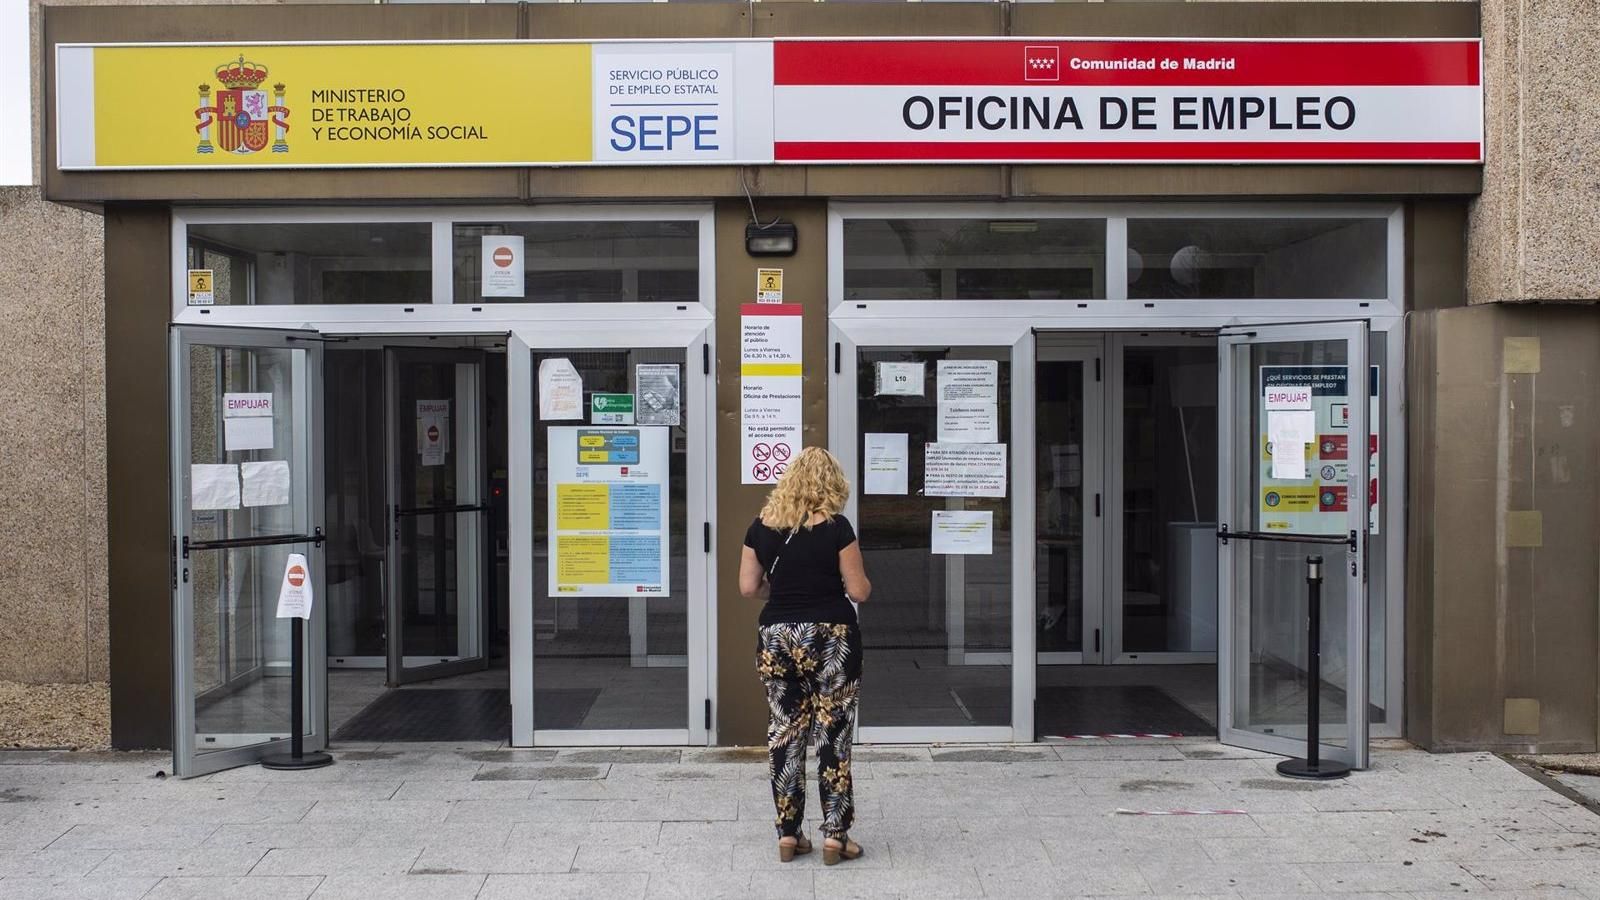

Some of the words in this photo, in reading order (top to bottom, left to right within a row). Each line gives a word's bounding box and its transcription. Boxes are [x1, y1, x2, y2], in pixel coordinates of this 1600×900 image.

[1069, 57, 1155, 71] Comunidad
[1160, 57, 1179, 70] de
[1183, 57, 1235, 70] Madrid
[609, 69, 663, 81] SERVICIO
[666, 67, 719, 80] PÚBLICO
[311, 88, 406, 103] MINISTERIO
[609, 84, 625, 95] DE
[627, 84, 671, 95] EMPLEO
[674, 84, 719, 95] ESTATAL
[312, 108, 334, 122] DE
[334, 107, 411, 125] TRABAJO
[902, 95, 1084, 131] OFICINA
[1099, 96, 1158, 130] DE
[1172, 95, 1356, 131] EMPLEO
[311, 127, 323, 141] Y
[328, 121, 423, 141] ECONOMÍA
[427, 125, 489, 140] SOCIAL
[610, 114, 720, 152] SEPE
[228, 400, 269, 410] EMPUJAR
[1268, 393, 1308, 403] EMPUJAR
